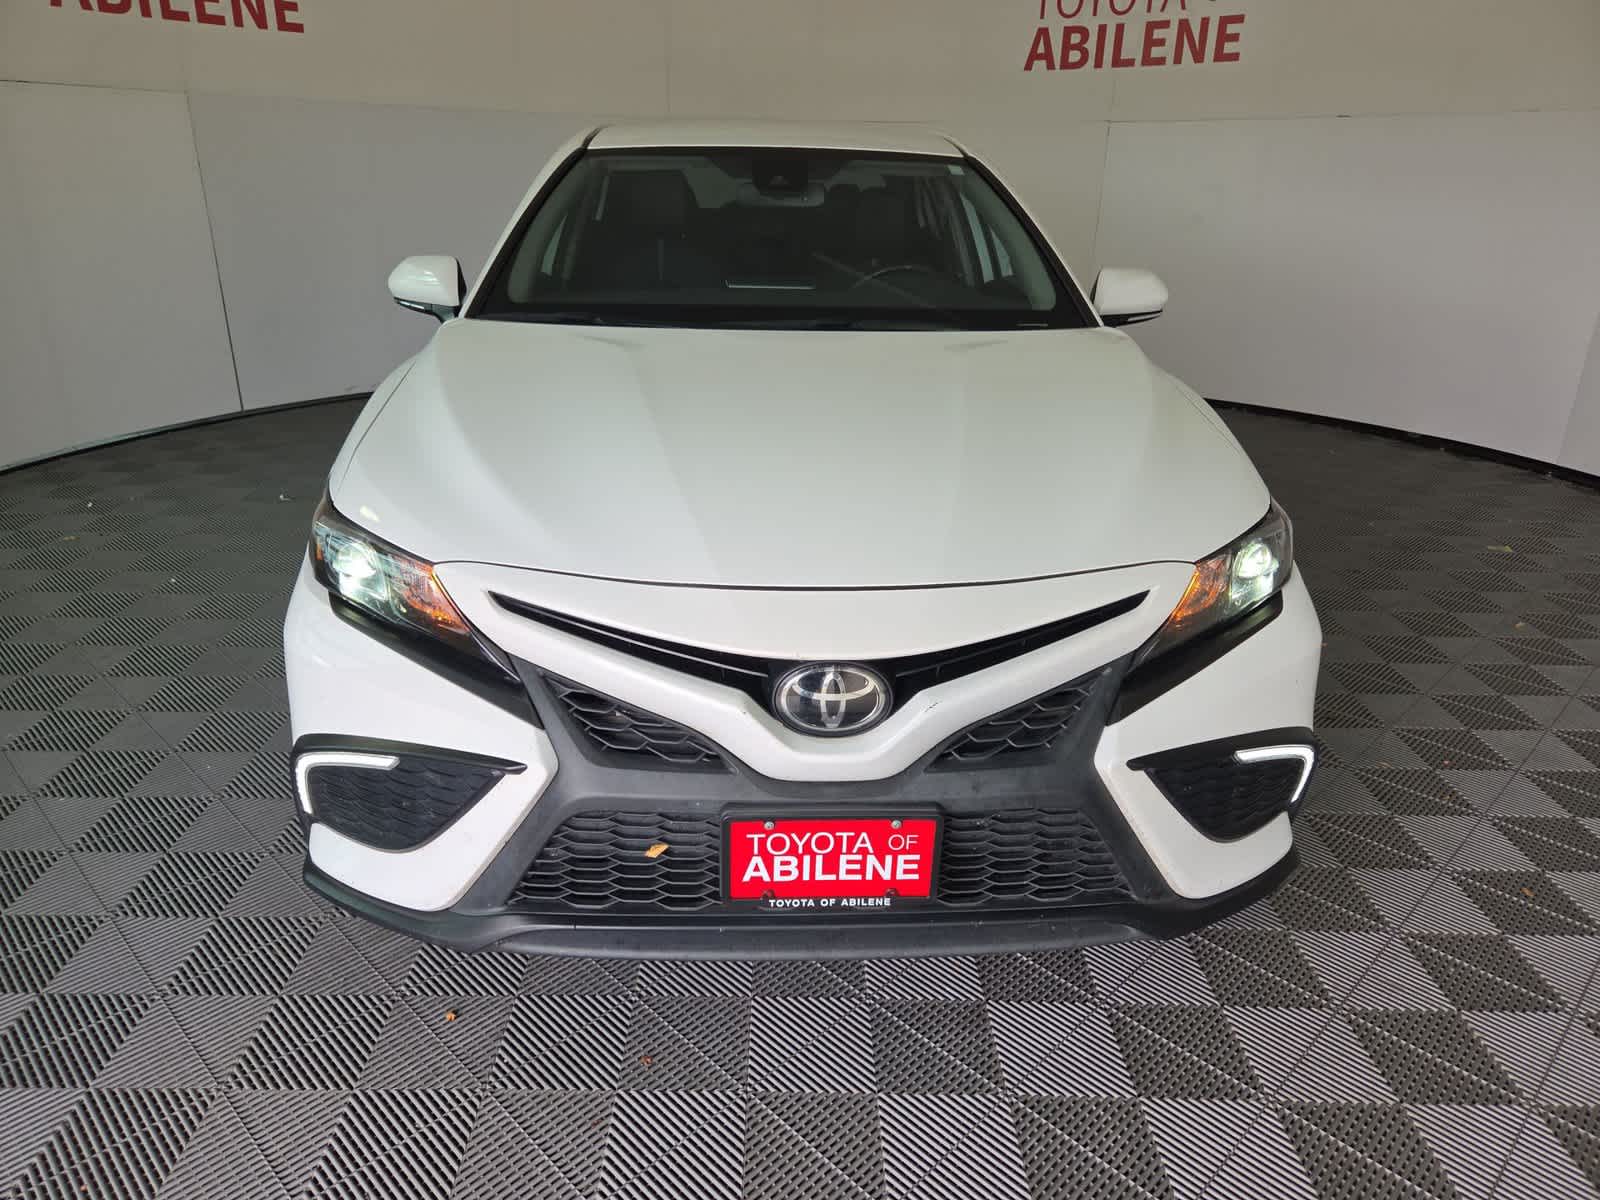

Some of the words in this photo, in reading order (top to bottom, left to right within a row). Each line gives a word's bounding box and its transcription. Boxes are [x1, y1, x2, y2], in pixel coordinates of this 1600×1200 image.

[1023, 14, 1245, 71] ABILENE
[746, 831, 874, 855] TOYOTA
[887, 834, 919, 851] OF
[742, 854, 920, 882] ABILENE
[768, 899, 815, 908] TOYOTA
[820, 898, 836, 907] OF
[841, 897, 891, 906] ABILENE
